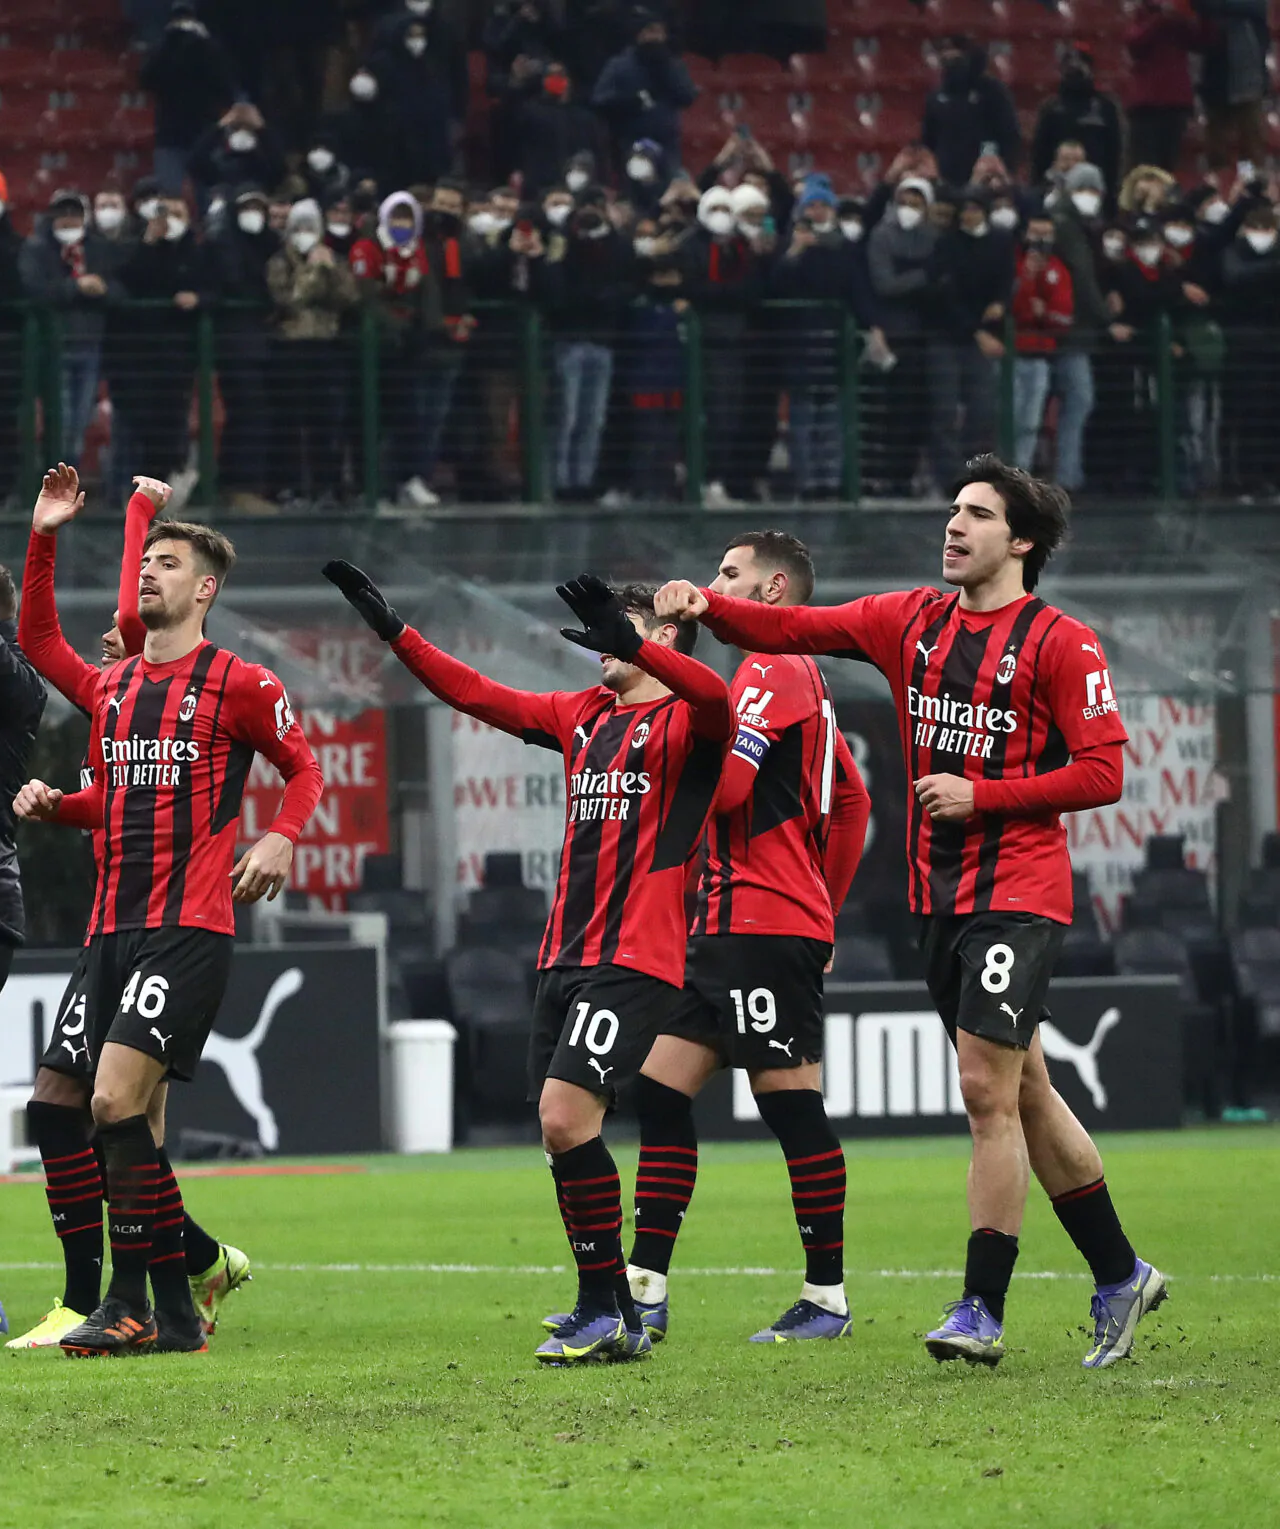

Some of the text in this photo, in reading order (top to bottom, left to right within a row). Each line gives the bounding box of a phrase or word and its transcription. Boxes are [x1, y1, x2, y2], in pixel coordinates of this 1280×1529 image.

[907, 685, 1018, 734] Emirates
[1082, 699, 1119, 721] BitME
[101, 733, 200, 763] Emirates
[734, 734, 764, 757] TANO
[914, 721, 995, 759] FLY BETTER
[112, 764, 131, 787] FLY
[132, 763, 181, 786] BETTER
[570, 767, 652, 798] mirates
[579, 797, 630, 821] BETTER
[980, 943, 1016, 996] 8
[120, 971, 170, 1019] 46
[730, 987, 777, 1034] 19
[568, 1001, 620, 1056] 10
[112, 1224, 143, 1234] ACM
[572, 1241, 596, 1252] CM
